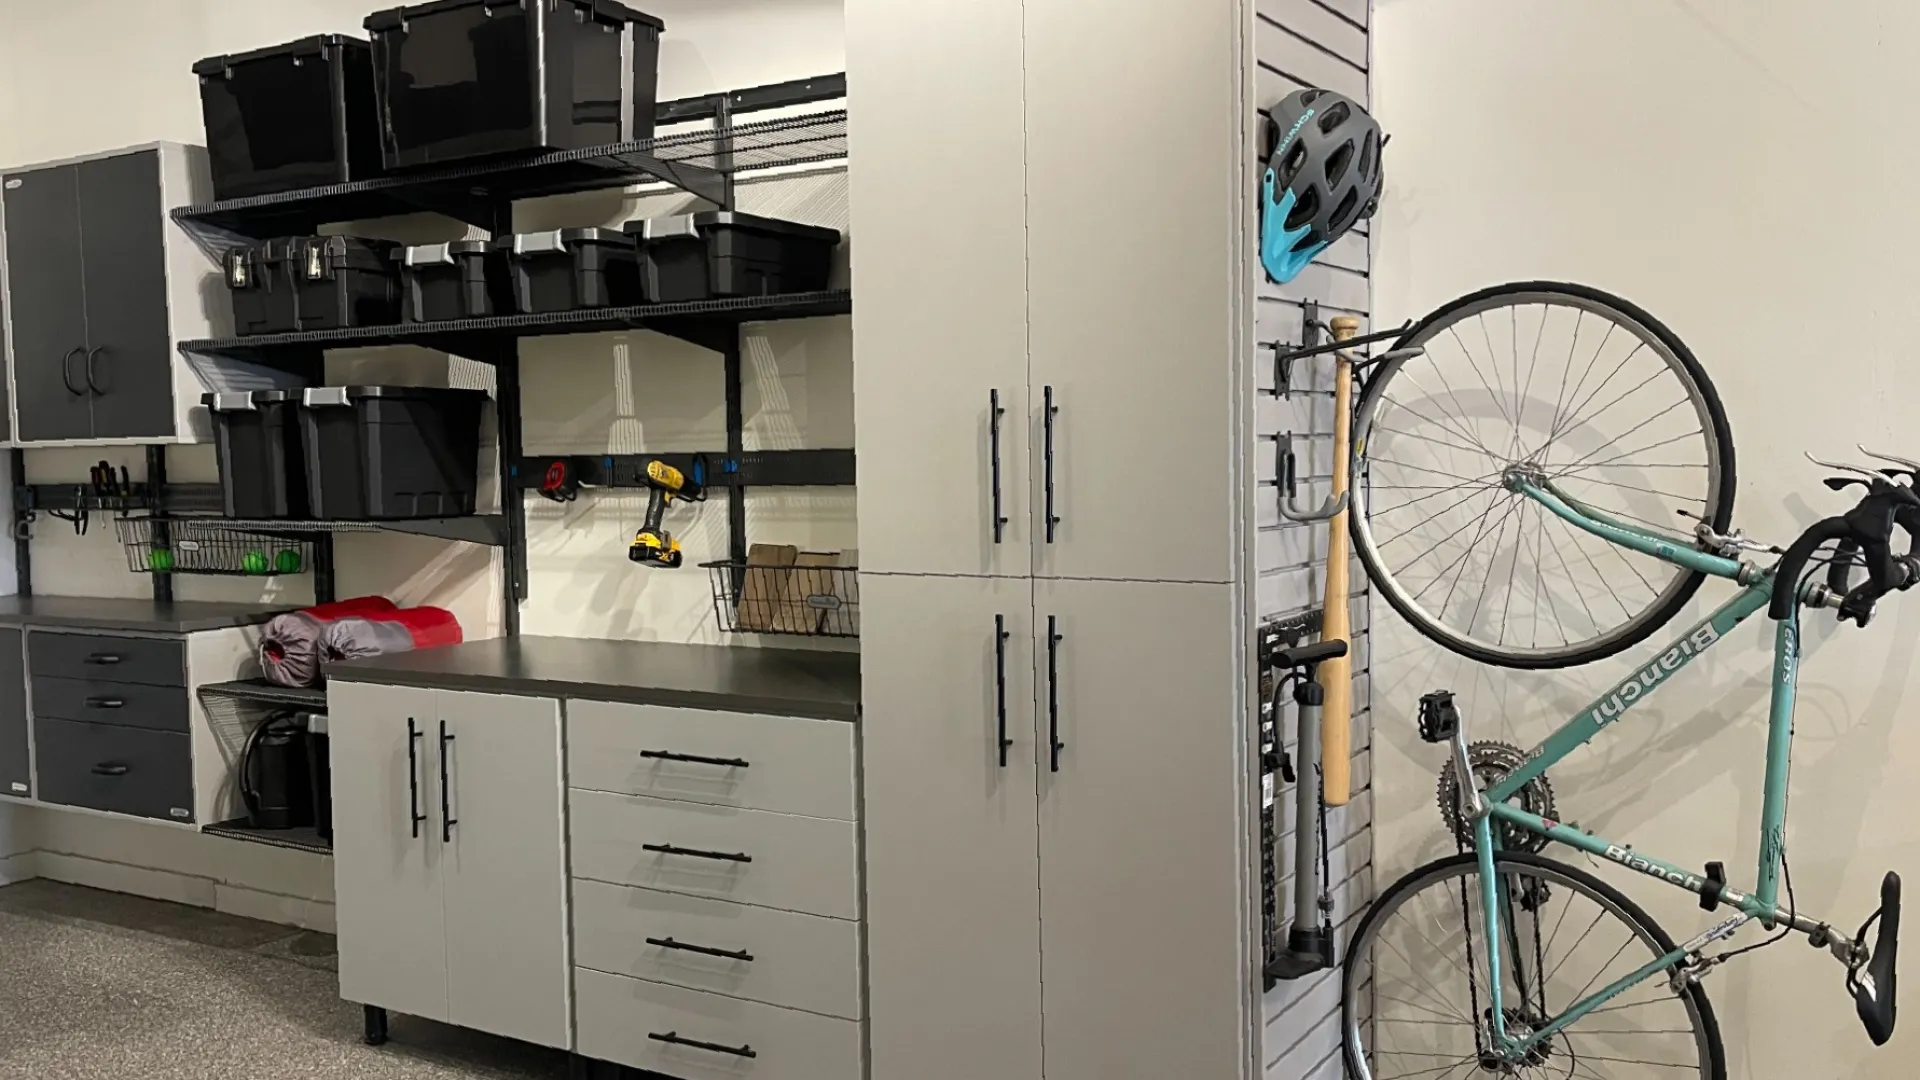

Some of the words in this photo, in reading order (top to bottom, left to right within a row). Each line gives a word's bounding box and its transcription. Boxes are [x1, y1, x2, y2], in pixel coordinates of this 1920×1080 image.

[1276, 108, 1314, 156] SCHWINN
[1591, 621, 1720, 728] Bianchi
[1605, 845, 1703, 892] Bianch
